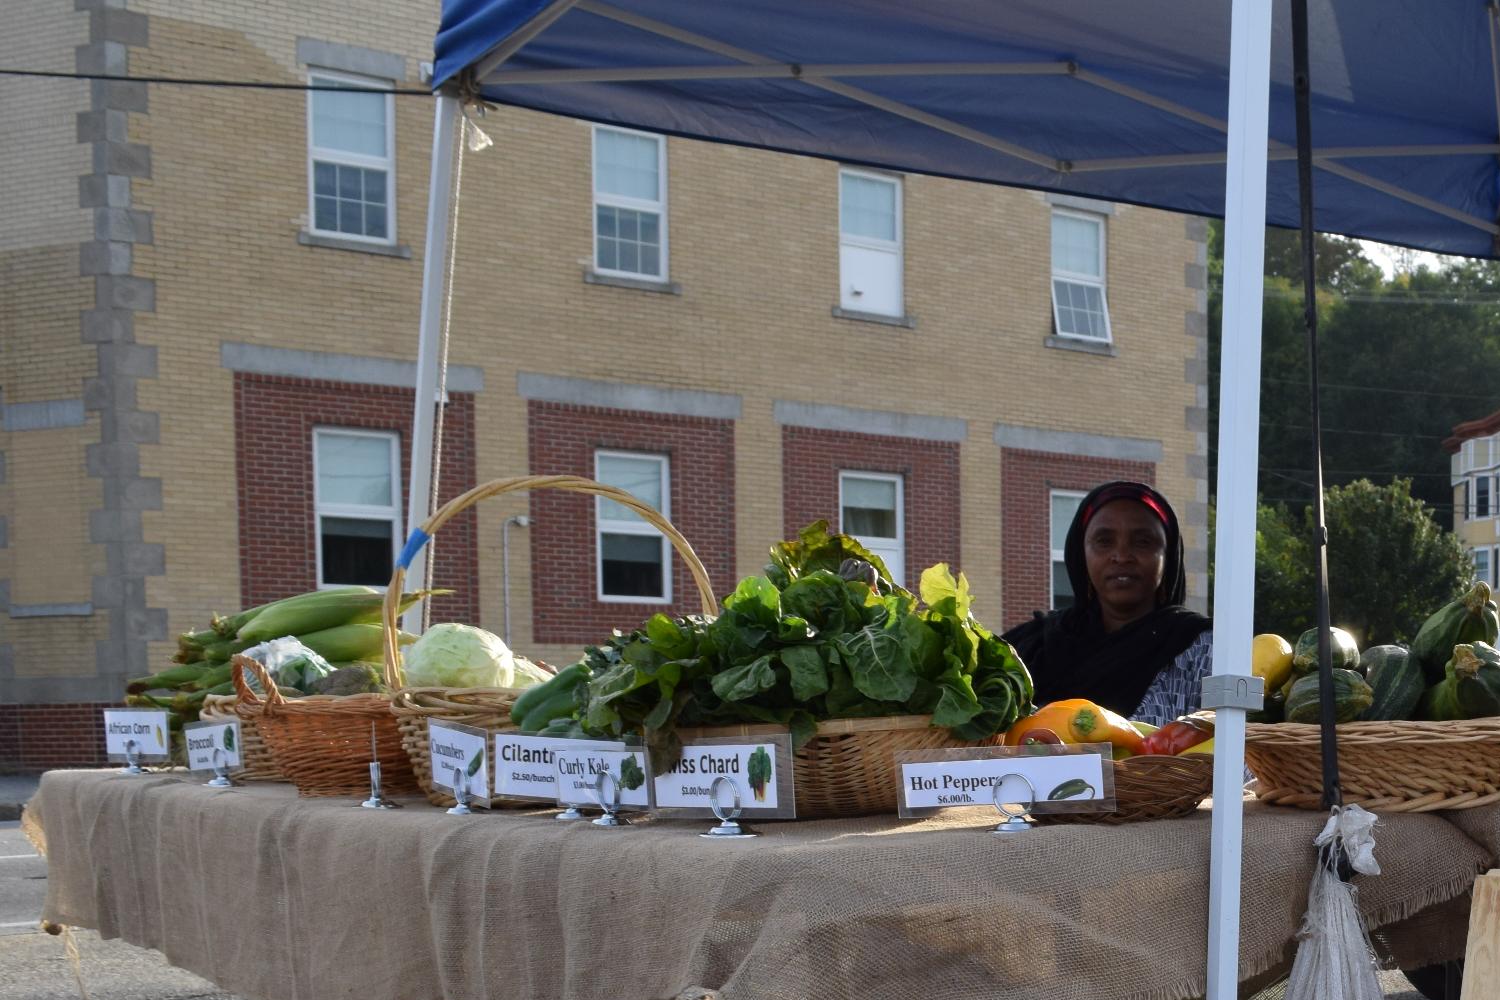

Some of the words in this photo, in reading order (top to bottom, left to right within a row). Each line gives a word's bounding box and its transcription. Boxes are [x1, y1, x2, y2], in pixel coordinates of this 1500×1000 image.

[188, 734, 215, 750] Broccoli
[431, 738, 465, 761] Cucumbers
[502, 744, 555, 765] Cilantr
[700, 752, 740, 774] Chard
[511, 772, 555, 783] $2.50/bunch
[558, 757, 585, 779] Curly
[910, 775, 939, 791] Hot
[942, 774, 1003, 792] Peppers
[937, 793, 975, 804] $6.00/lb.
